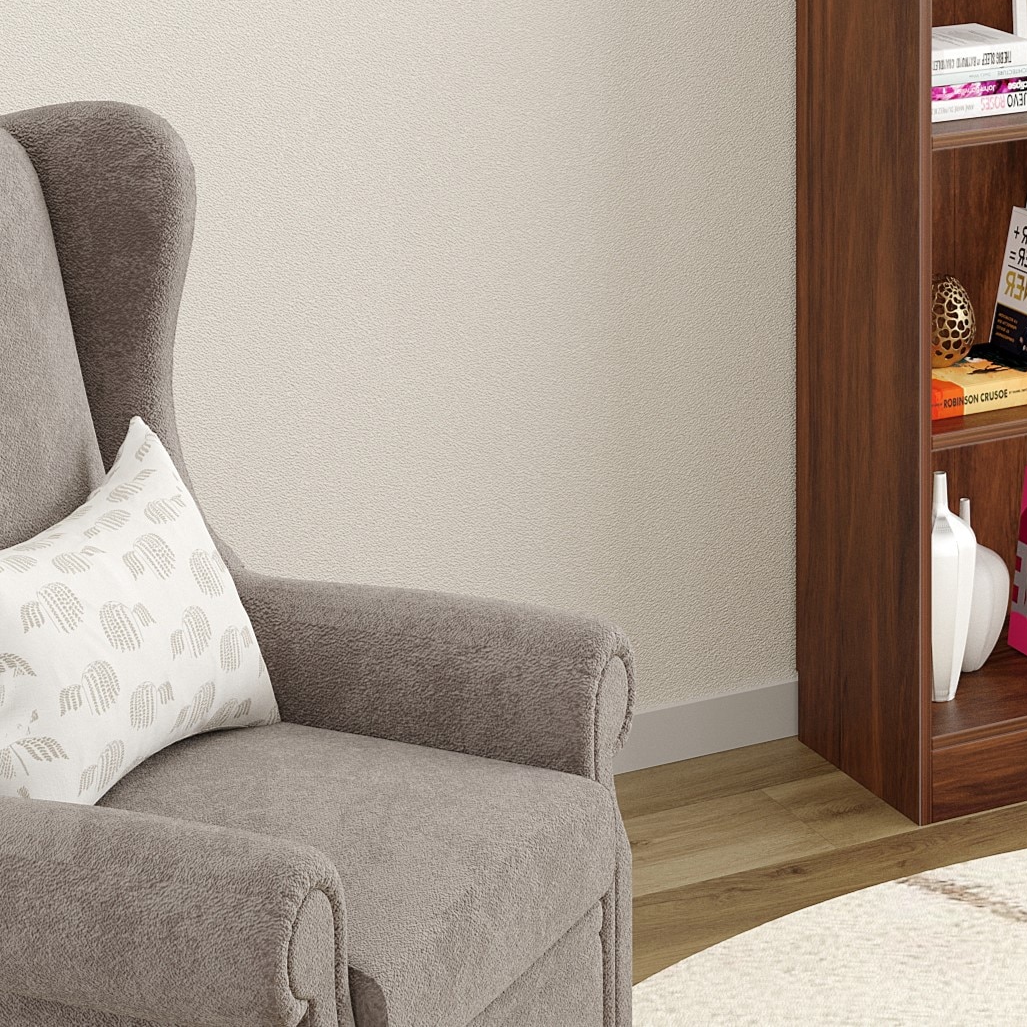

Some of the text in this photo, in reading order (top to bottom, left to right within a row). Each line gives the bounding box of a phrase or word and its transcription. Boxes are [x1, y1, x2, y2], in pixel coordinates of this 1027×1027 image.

[981, 96, 1006, 112] ROSES
[943, 394, 979, 408] ROBINSON
[980, 389, 1008, 403] CRUSOE
